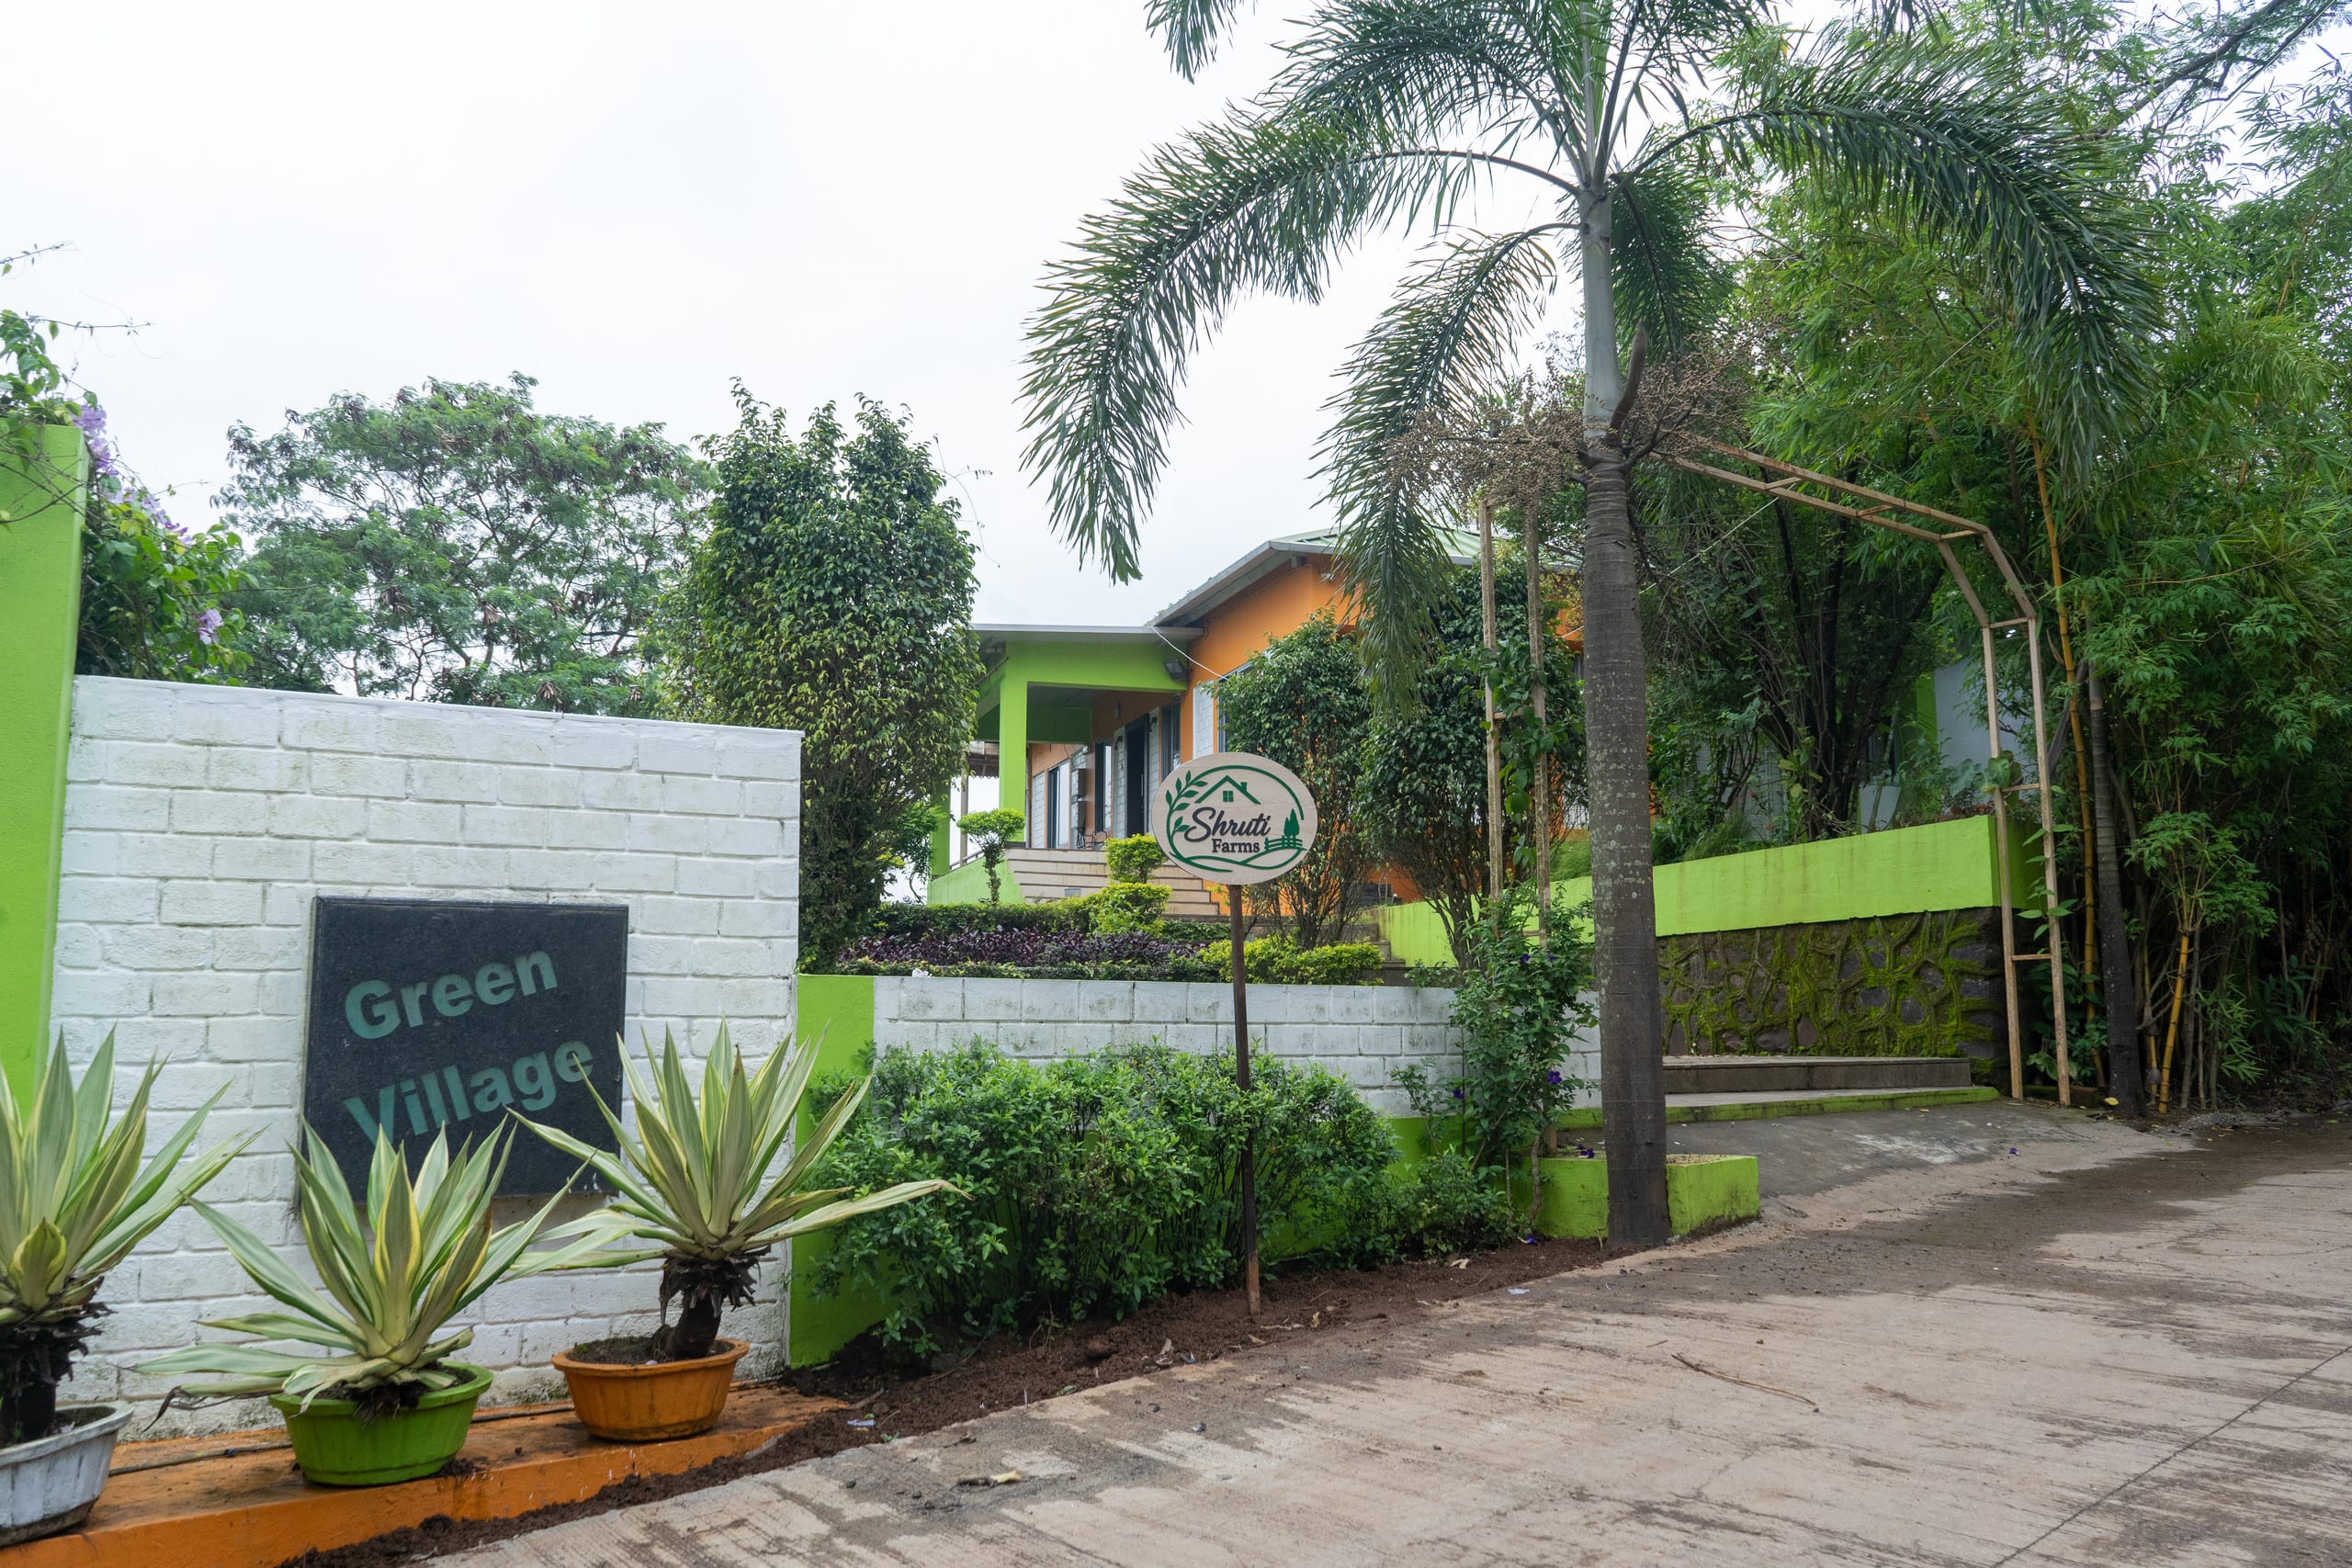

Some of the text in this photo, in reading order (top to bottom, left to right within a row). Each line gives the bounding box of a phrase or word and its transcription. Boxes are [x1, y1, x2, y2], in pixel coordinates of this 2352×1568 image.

[1184, 807, 1271, 842] Shruti
[1212, 838, 1261, 853] Farms
[345, 950, 558, 1040] Green
[344, 1041, 594, 1147] Village
